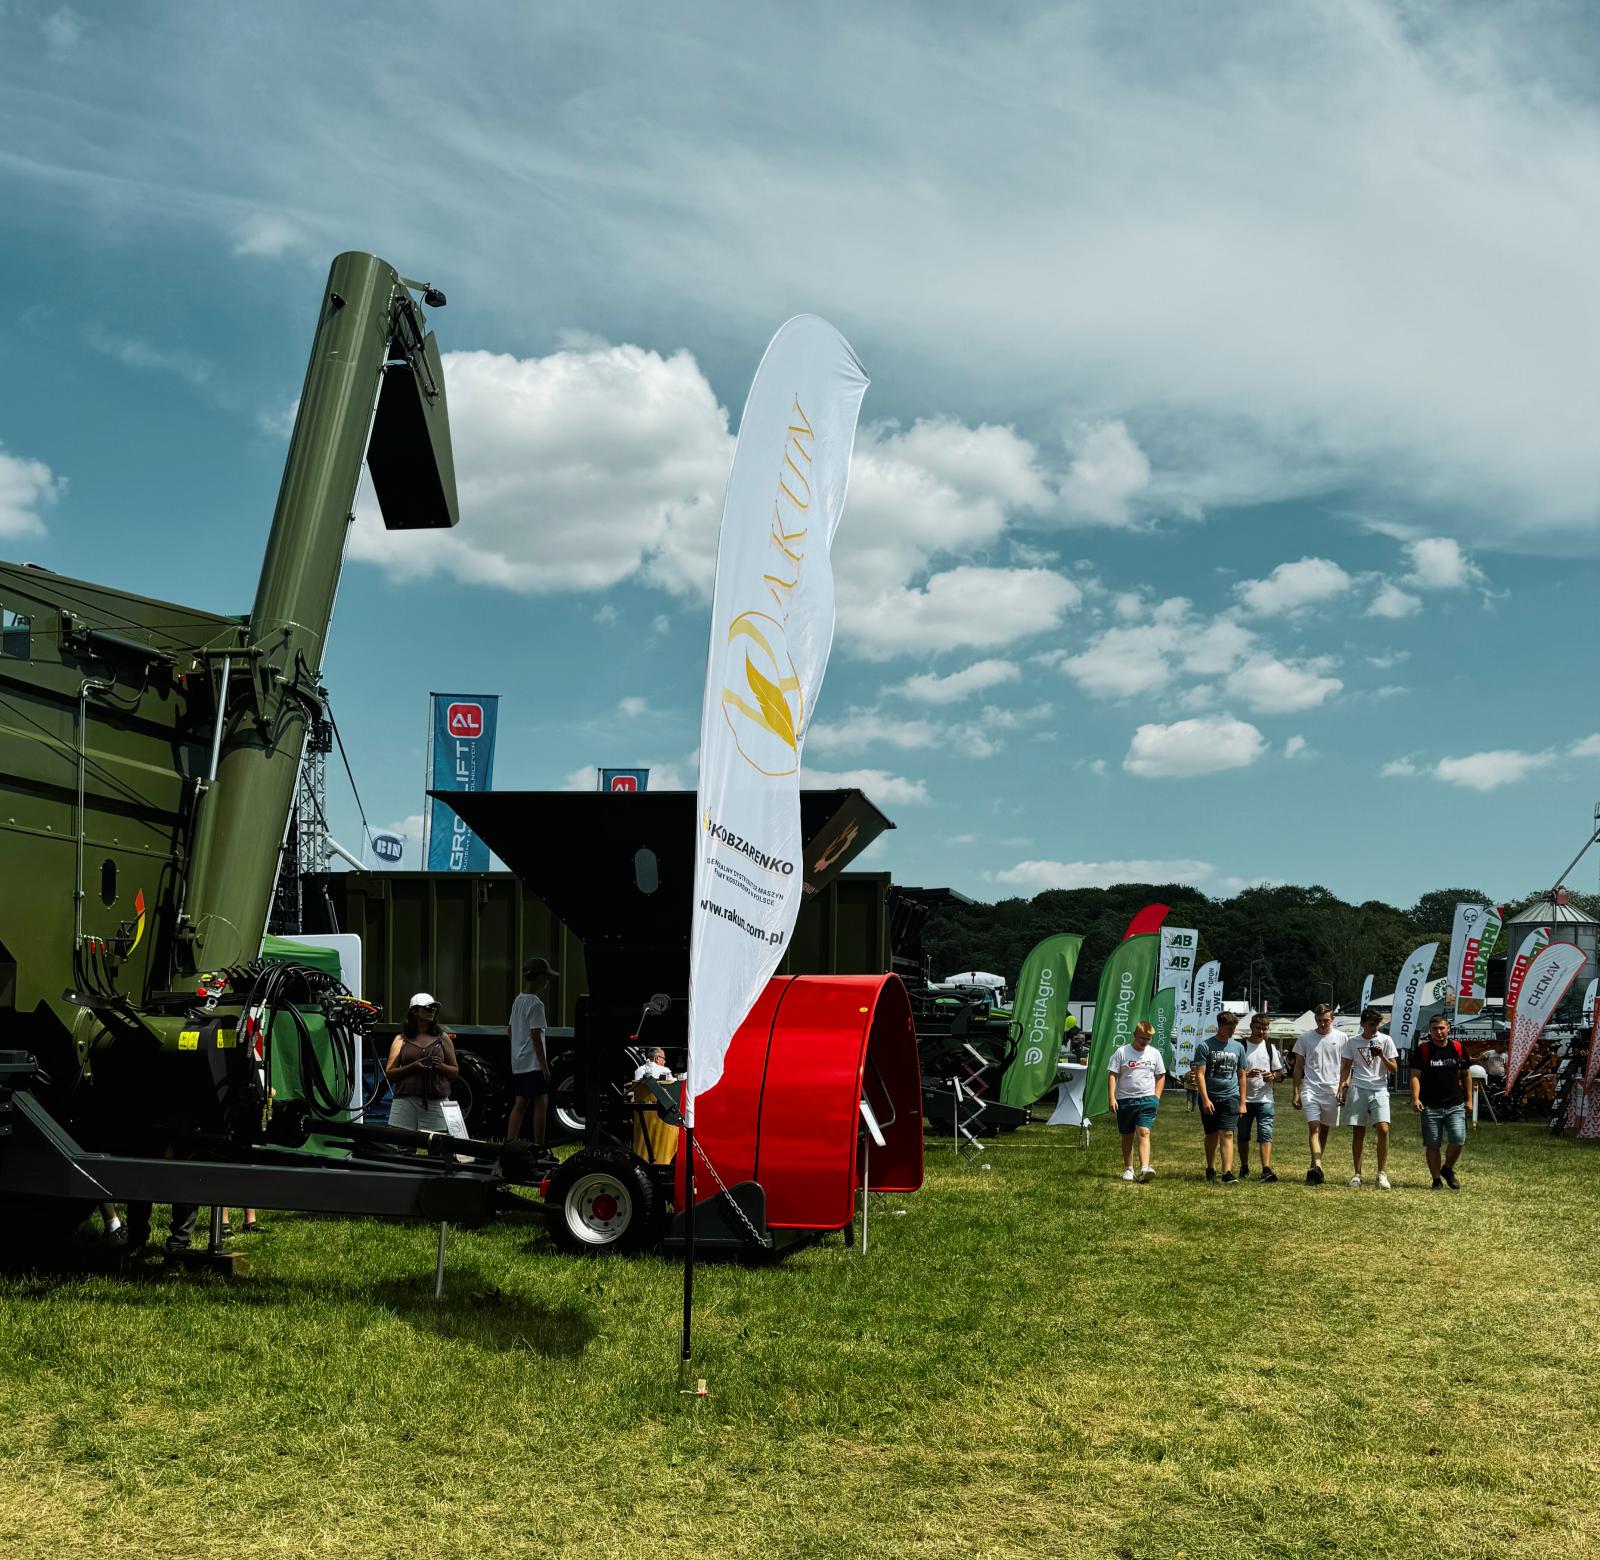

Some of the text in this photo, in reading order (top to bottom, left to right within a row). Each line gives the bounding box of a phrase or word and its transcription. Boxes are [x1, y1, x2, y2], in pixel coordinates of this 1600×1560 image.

[451, 713, 479, 728] AL
[376, 839, 401, 858] BIN
[711, 823, 794, 875] KOBZARENKO
[757, 887, 784, 900] MASZYN
[700, 899, 784, 946] www.rakun.com.pl
[1171, 934, 1193, 946] AB
[1170, 956, 1191, 968] AB
[1460, 937, 1481, 997] MORO
[1528, 961, 1561, 1007] CHCNAV
[1030, 968, 1055, 1043] OptiAgro
[1112, 971, 1134, 1049] OptiAgro
[1400, 978, 1419, 1037] agrosolar
